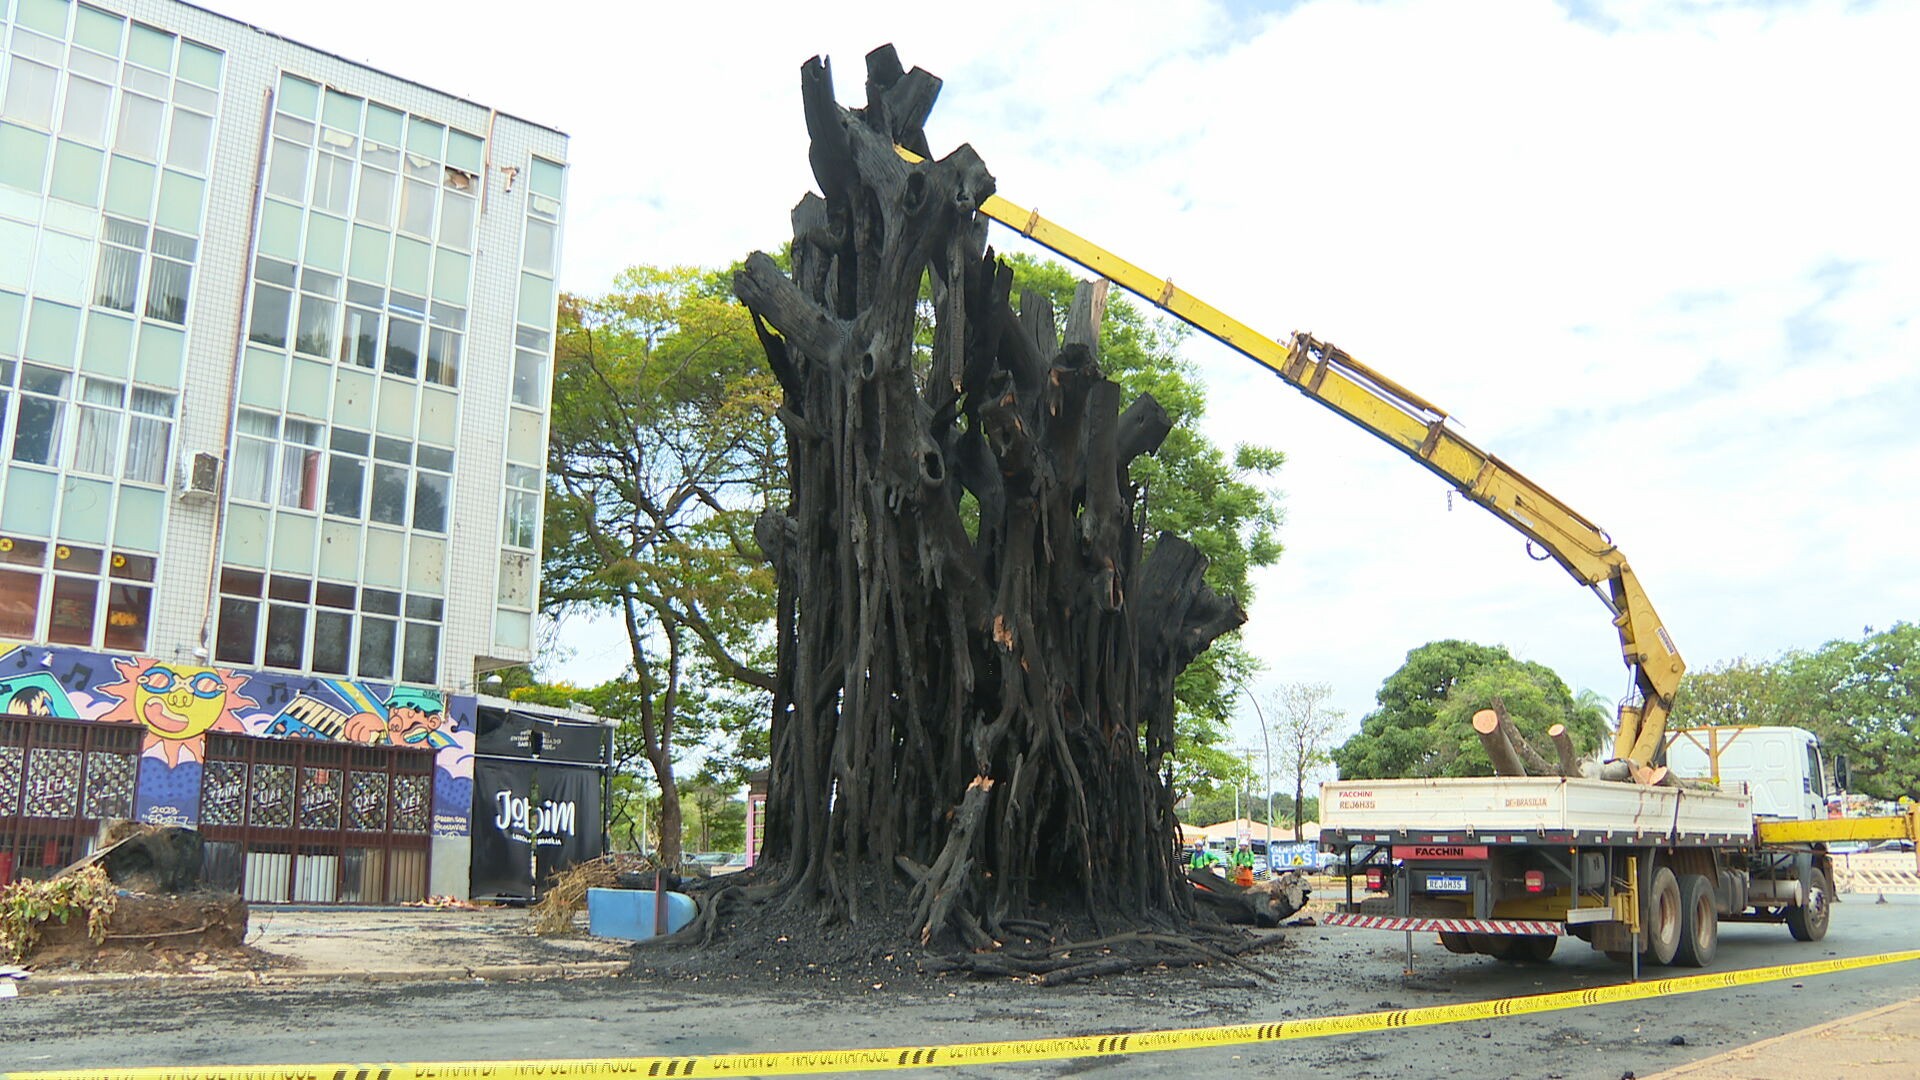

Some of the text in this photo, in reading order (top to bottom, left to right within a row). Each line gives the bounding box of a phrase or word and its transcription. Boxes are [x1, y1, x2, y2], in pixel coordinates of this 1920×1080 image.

[1292, 843, 1313, 853] NAS
[1415, 848, 1464, 856] FACCHINI
[1429, 880, 1462, 889] REJ6H35
